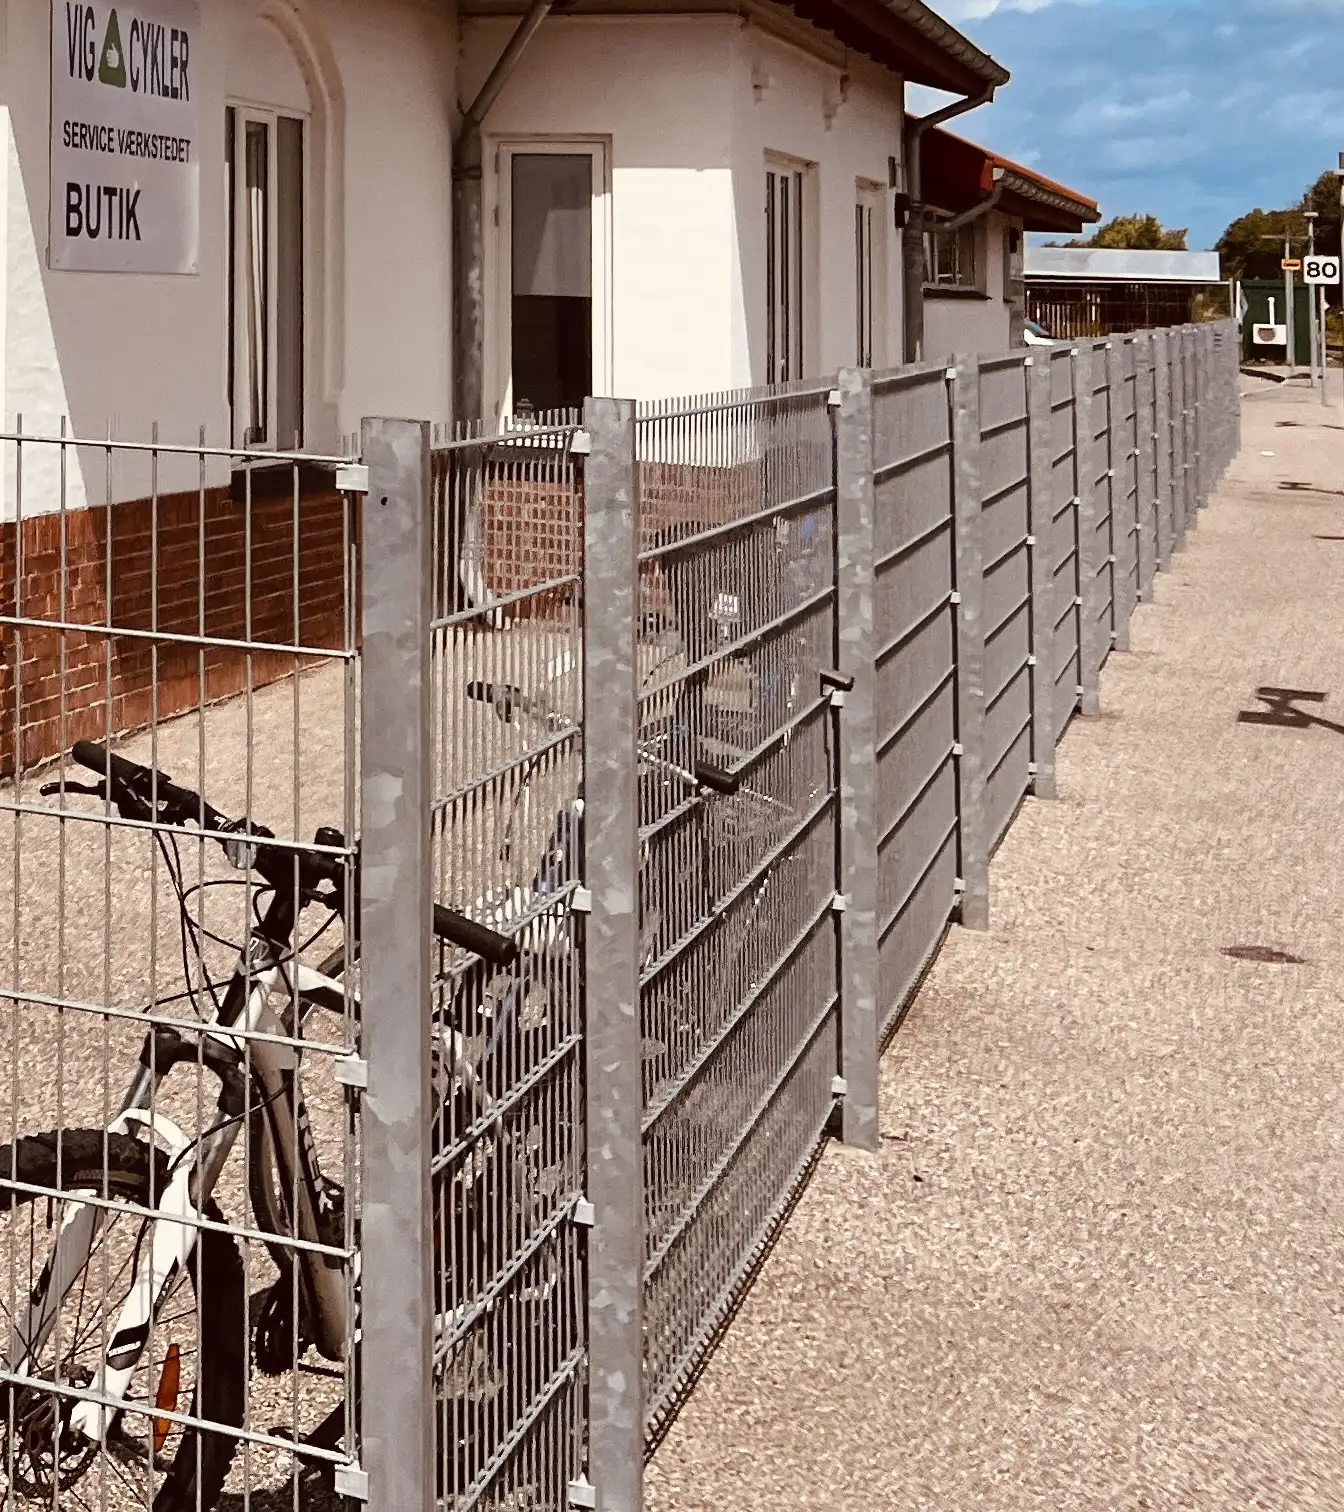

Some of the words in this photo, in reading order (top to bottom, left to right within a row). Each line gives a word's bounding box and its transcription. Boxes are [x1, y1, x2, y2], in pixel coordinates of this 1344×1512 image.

[66, 1, 96, 82] VIG
[129, 18, 190, 102] CYKLER
[62, 120, 115, 154] SERVICE
[117, 128, 191, 164] VÆRKSTEDET
[65, 182, 142, 241] BUTIK
[1306, 261, 1337, 278] 80
